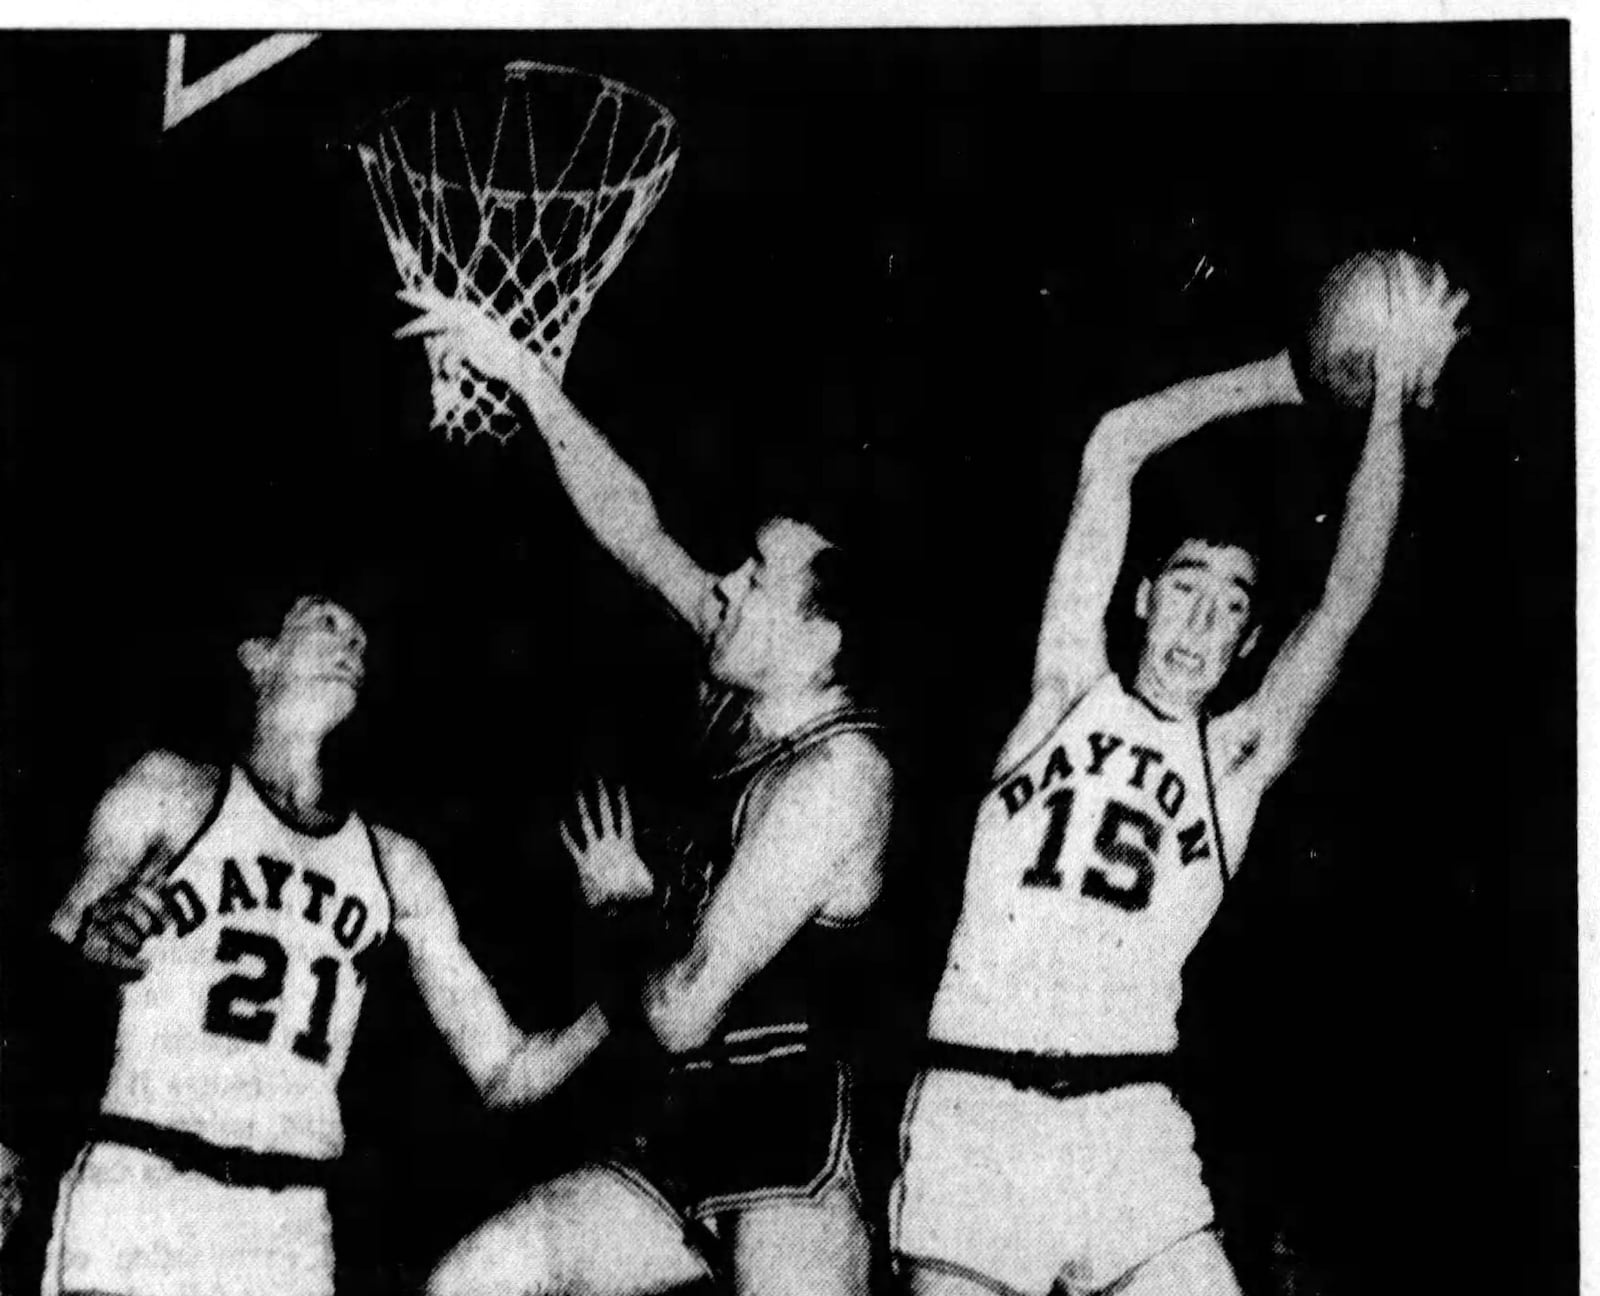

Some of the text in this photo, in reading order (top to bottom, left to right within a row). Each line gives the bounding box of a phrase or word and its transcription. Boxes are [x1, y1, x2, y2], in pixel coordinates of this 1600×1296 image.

[1000, 732, 1210, 868] DAYTON
[1020, 786, 1165, 914] 15
[160, 854, 380, 970] DAYTO
[200, 926, 342, 1067] 21
